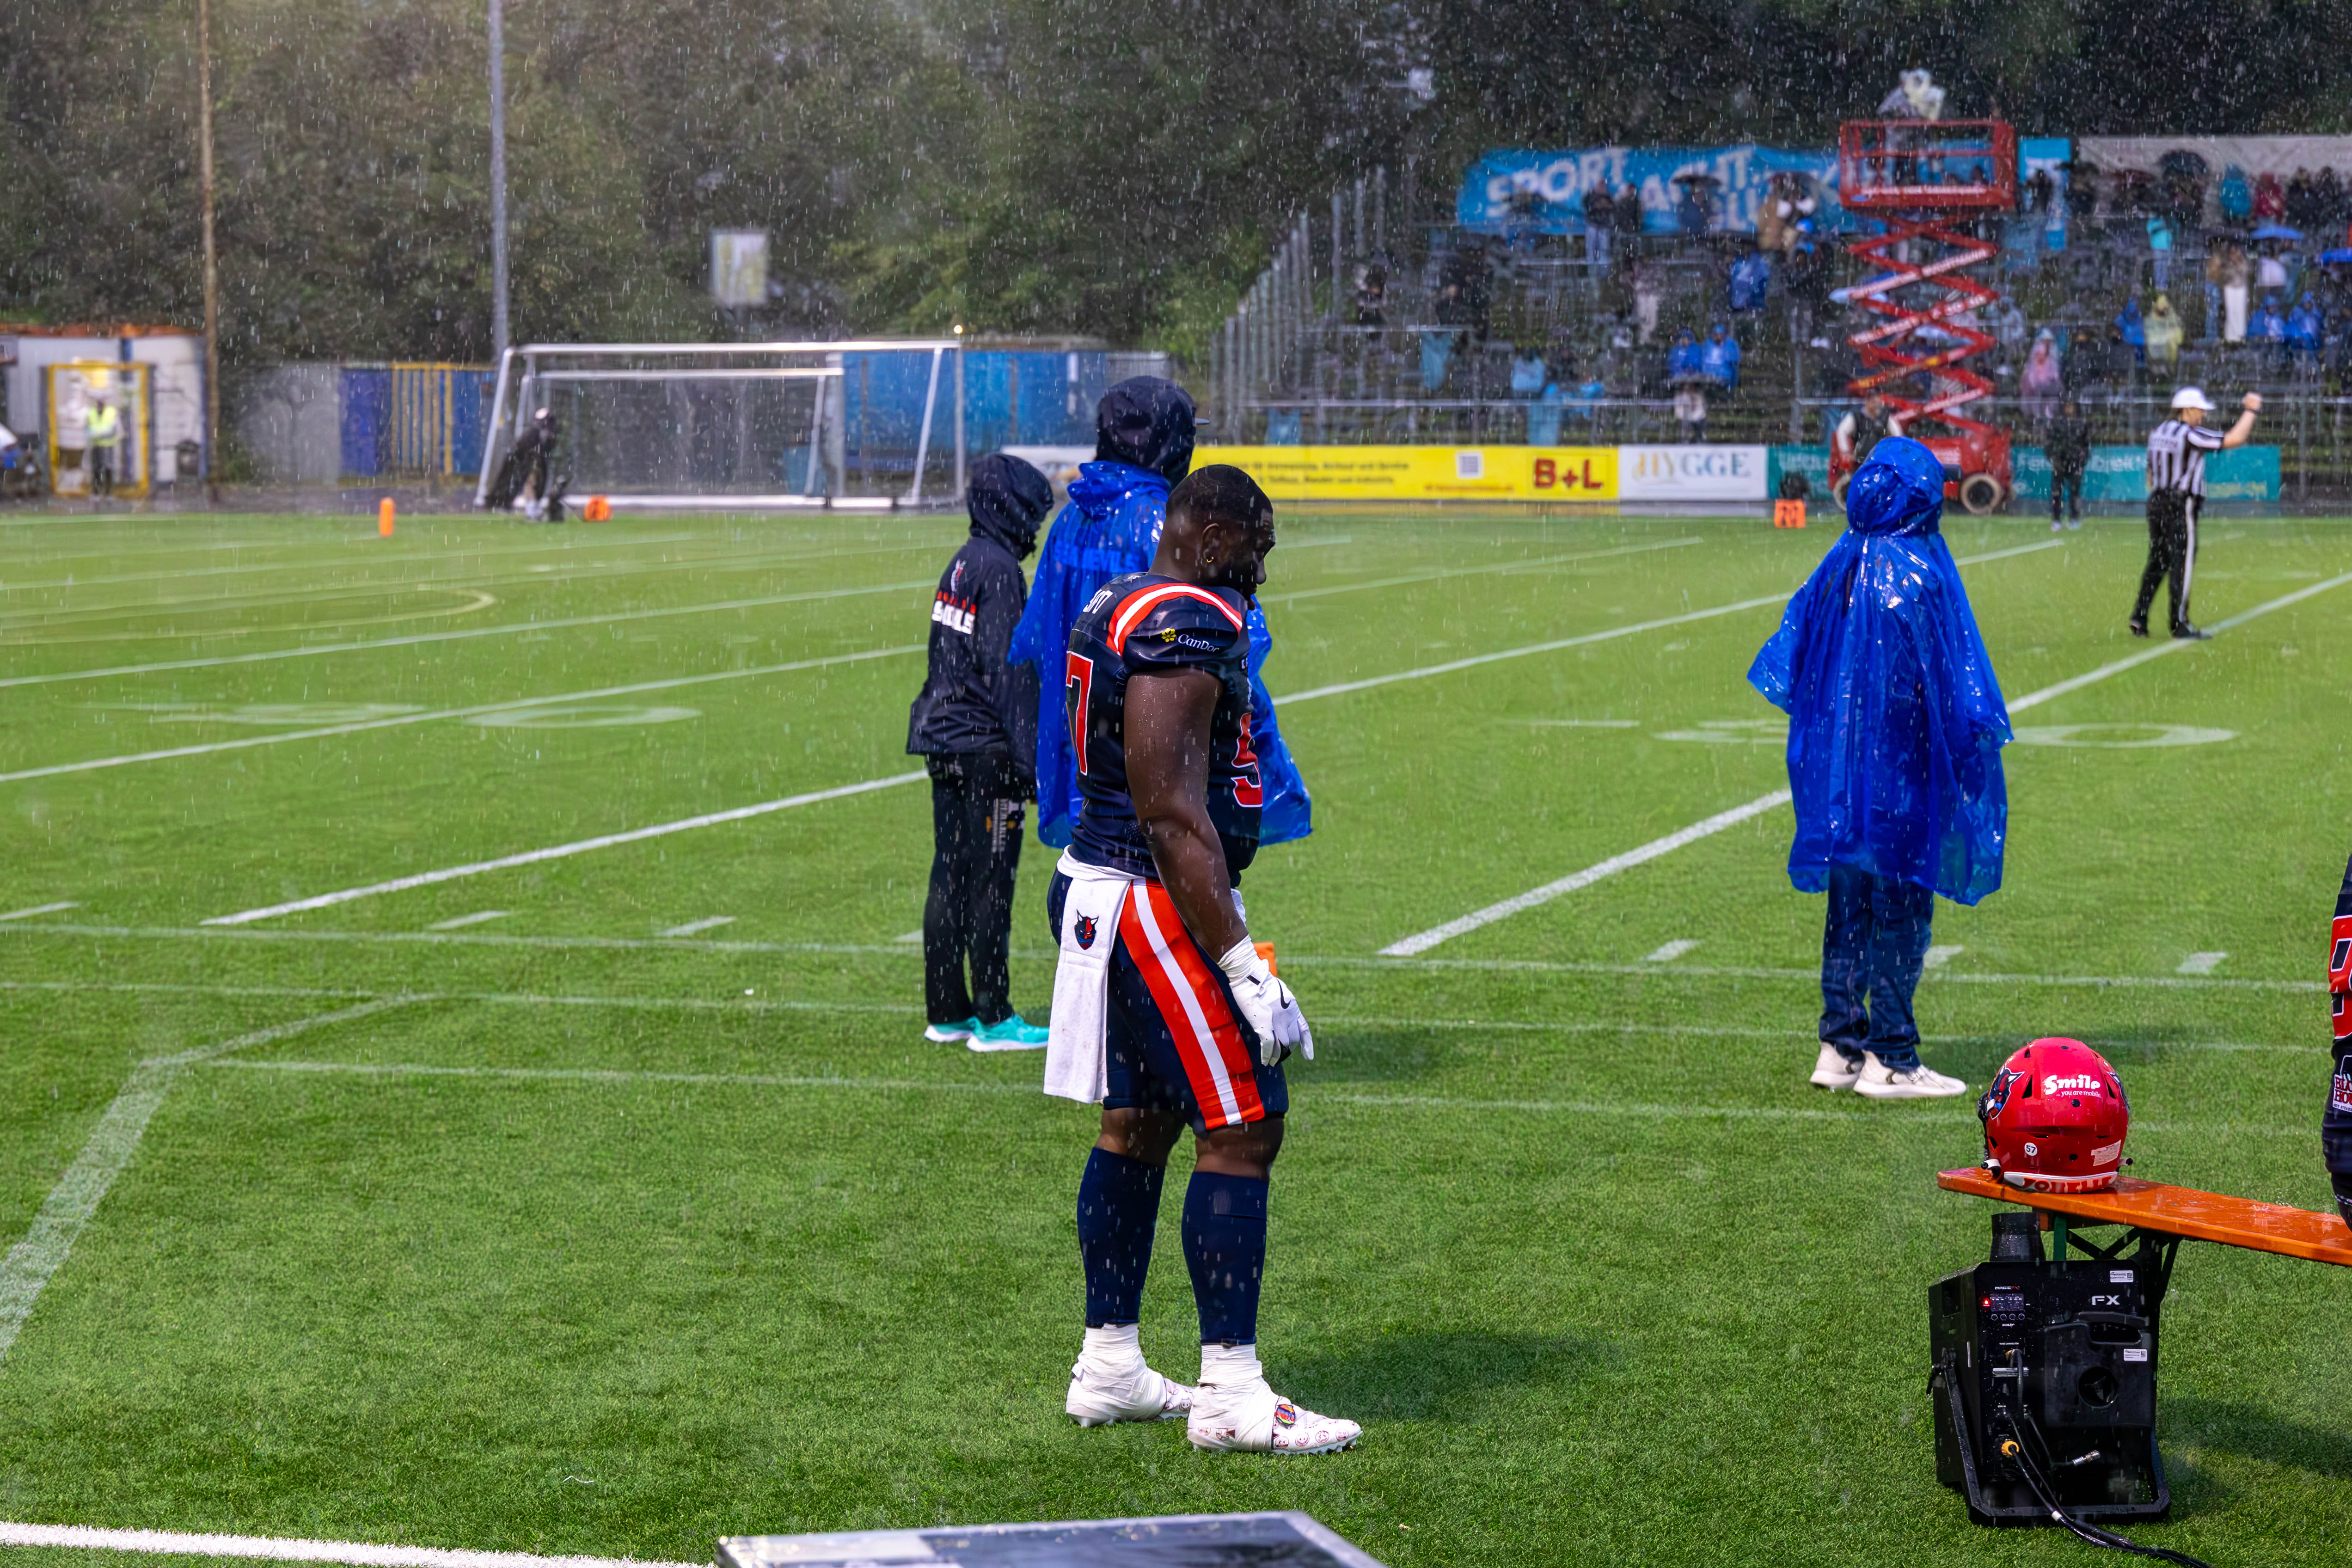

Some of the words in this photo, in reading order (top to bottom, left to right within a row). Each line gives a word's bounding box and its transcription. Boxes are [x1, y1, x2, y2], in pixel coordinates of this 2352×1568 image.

[1534, 458, 1604, 489] B+L
[1631, 452, 1751, 479] HYGGE
[1178, 634, 1219, 653] CanDor
[2042, 1074, 2101, 1095] Smile
[2092, 1295, 2120, 1305] FX
